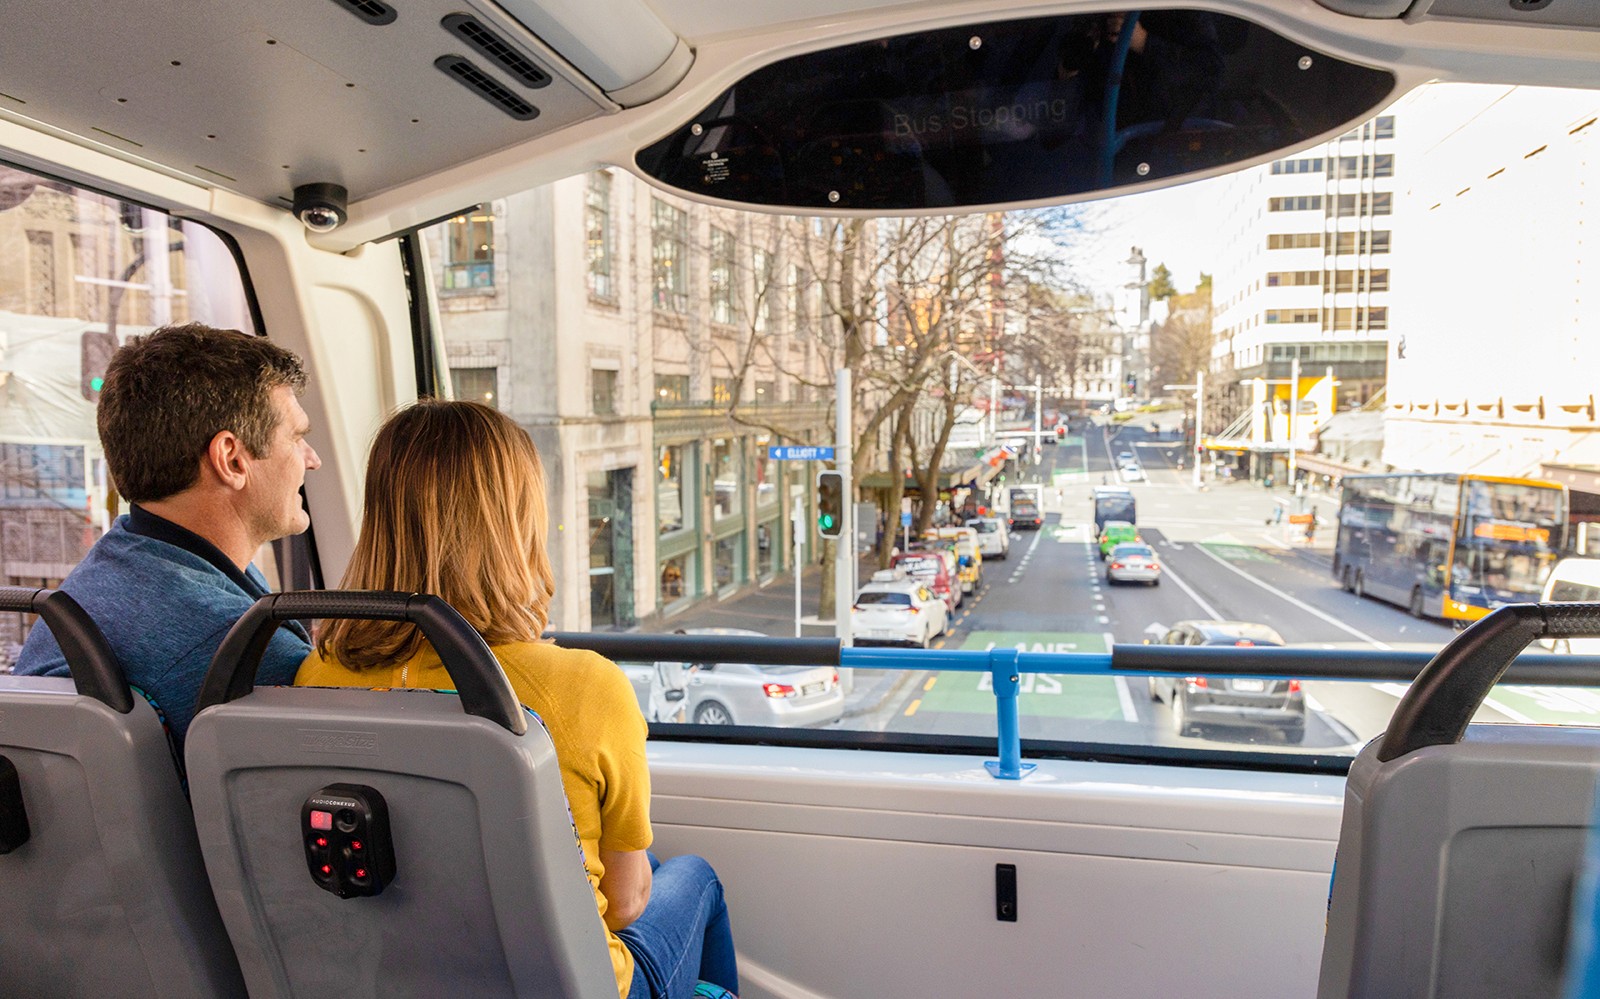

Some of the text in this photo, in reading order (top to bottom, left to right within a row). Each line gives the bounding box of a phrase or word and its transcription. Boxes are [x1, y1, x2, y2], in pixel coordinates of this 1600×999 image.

[894, 98, 1066, 137] Bus Stopping
[787, 447, 817, 460] ELLIOTT
[312, 799, 356, 807] AUDIOCONEXUS
